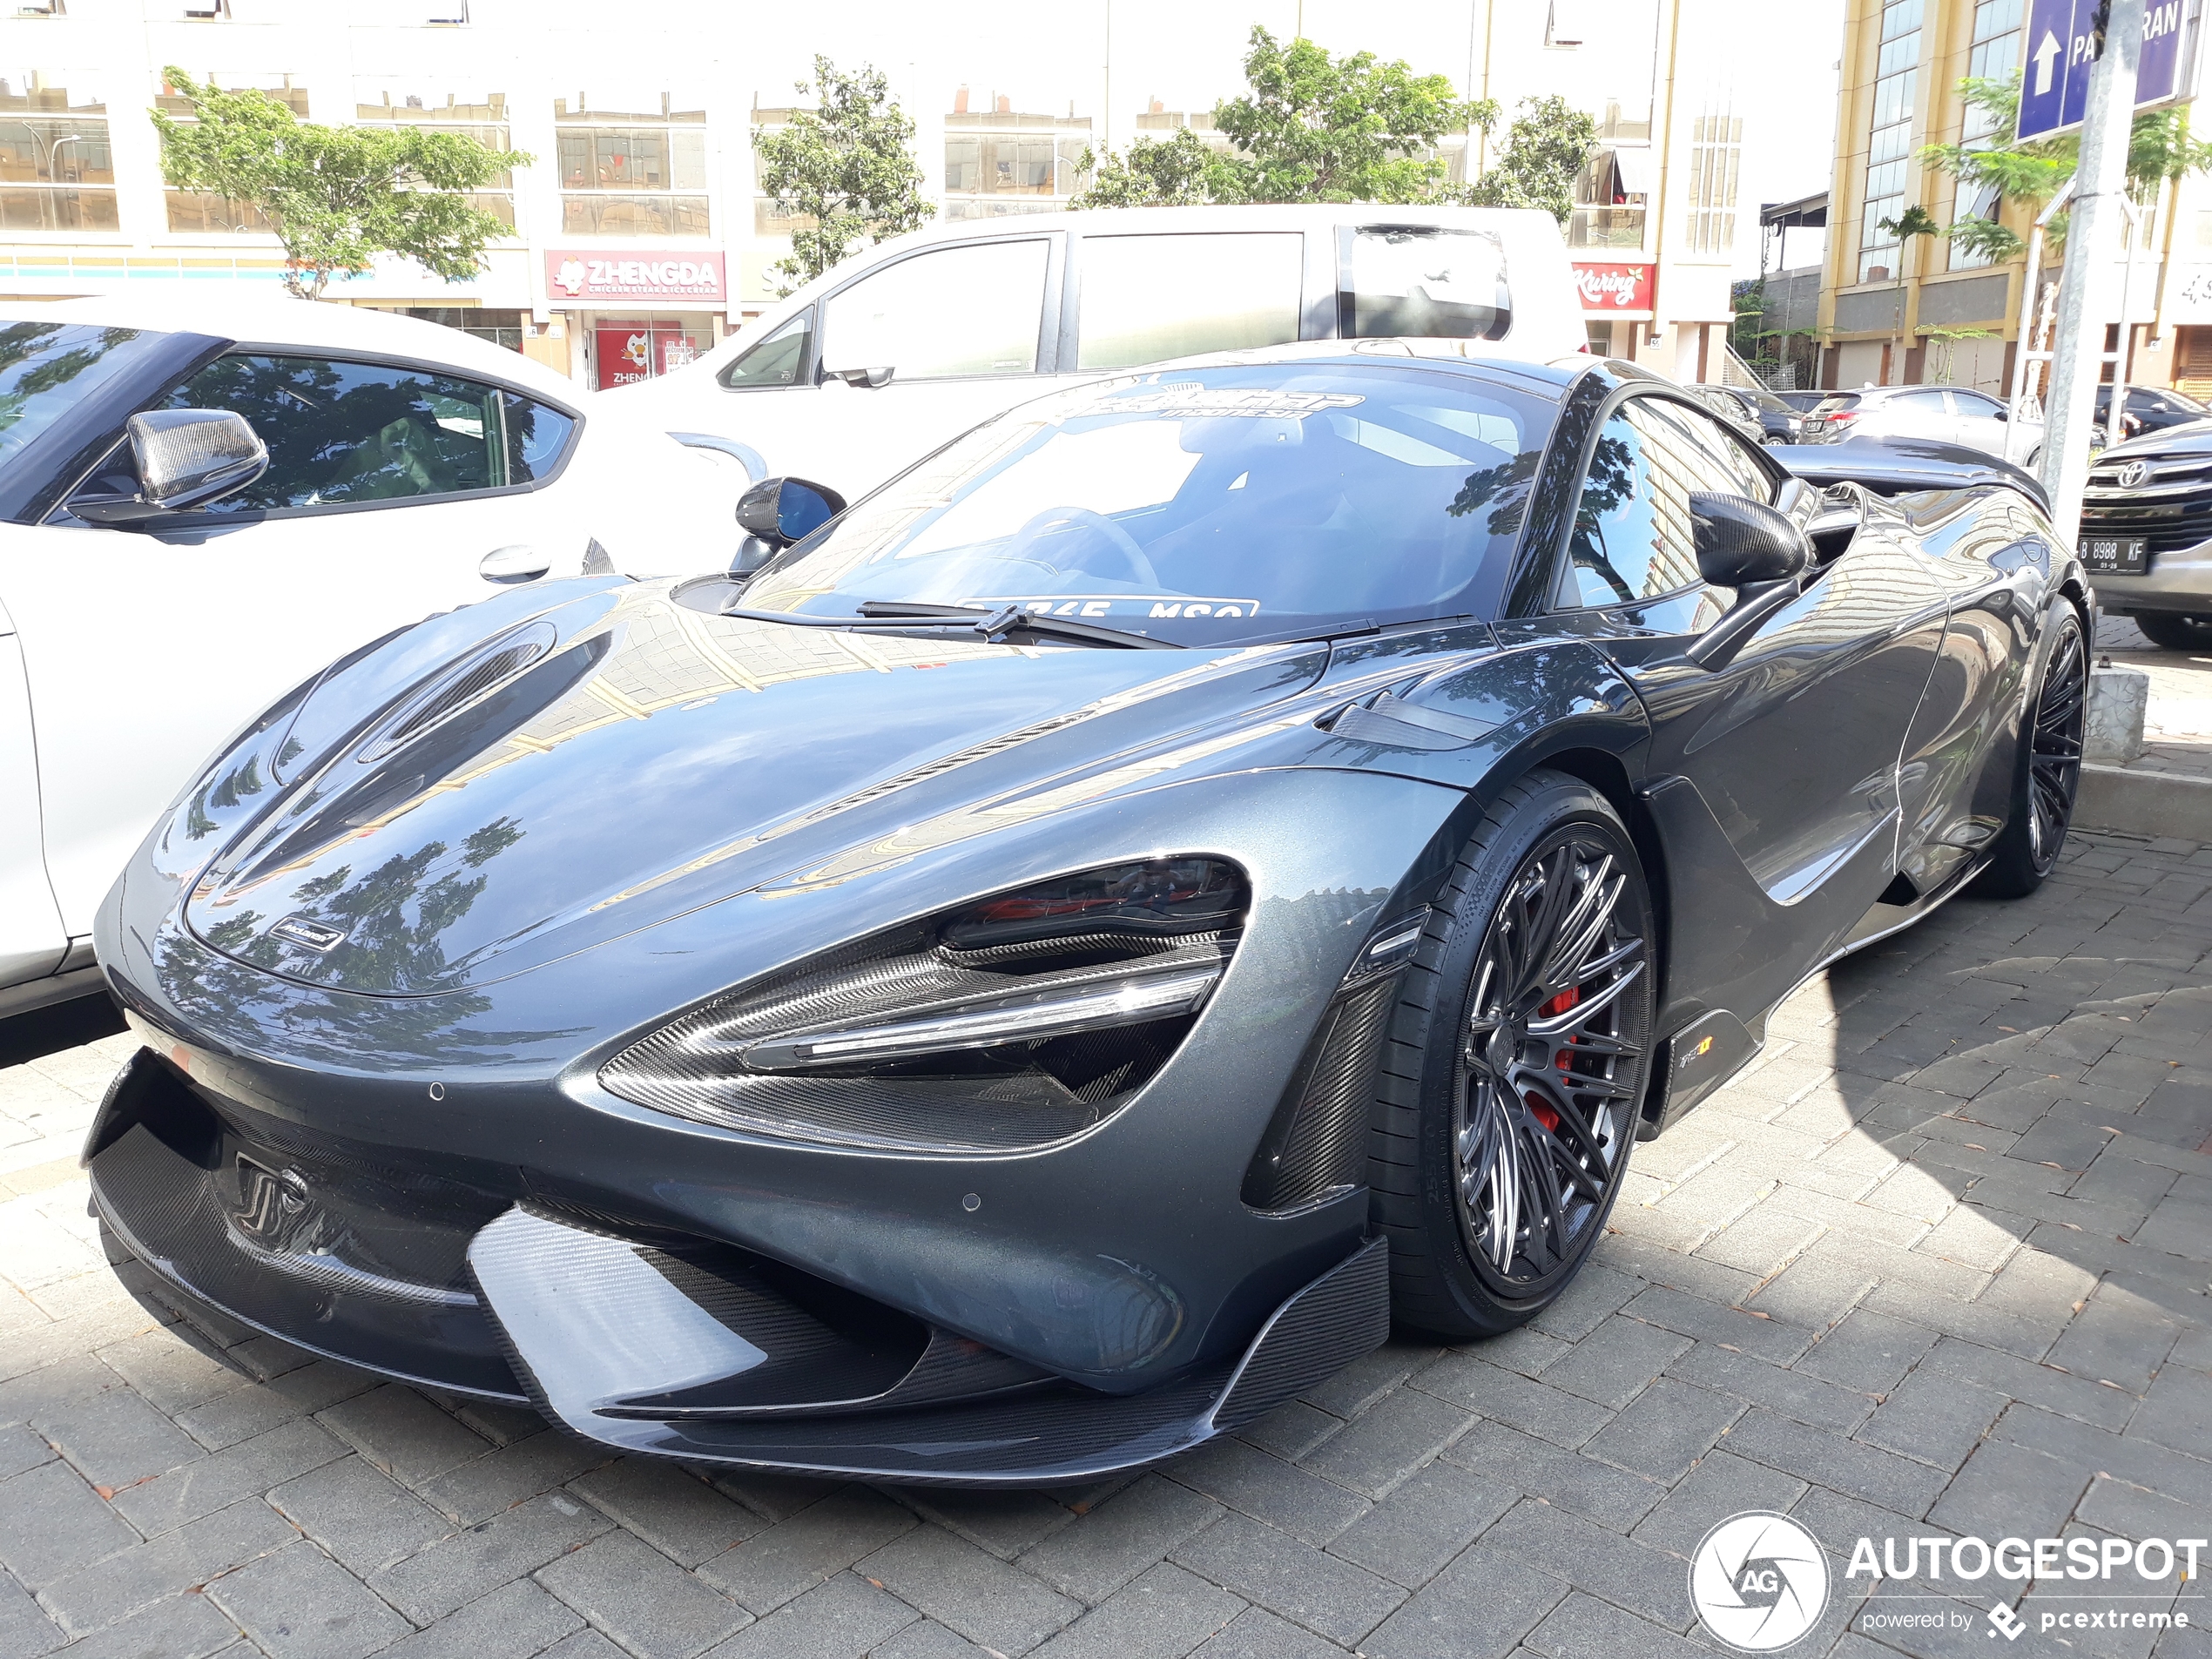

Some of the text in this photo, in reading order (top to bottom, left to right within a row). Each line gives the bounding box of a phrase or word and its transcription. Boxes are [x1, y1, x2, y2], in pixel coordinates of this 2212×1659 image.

[2073, 1, 2177, 66] PARAN
[588, 260, 718, 287] ZHENGDA
[589, 286, 630, 294] CHICKEN
[686, 287, 718, 295] CREAM
[2081, 542, 2143, 561] B 8988 KF
[280, 924, 327, 942] McLaren
